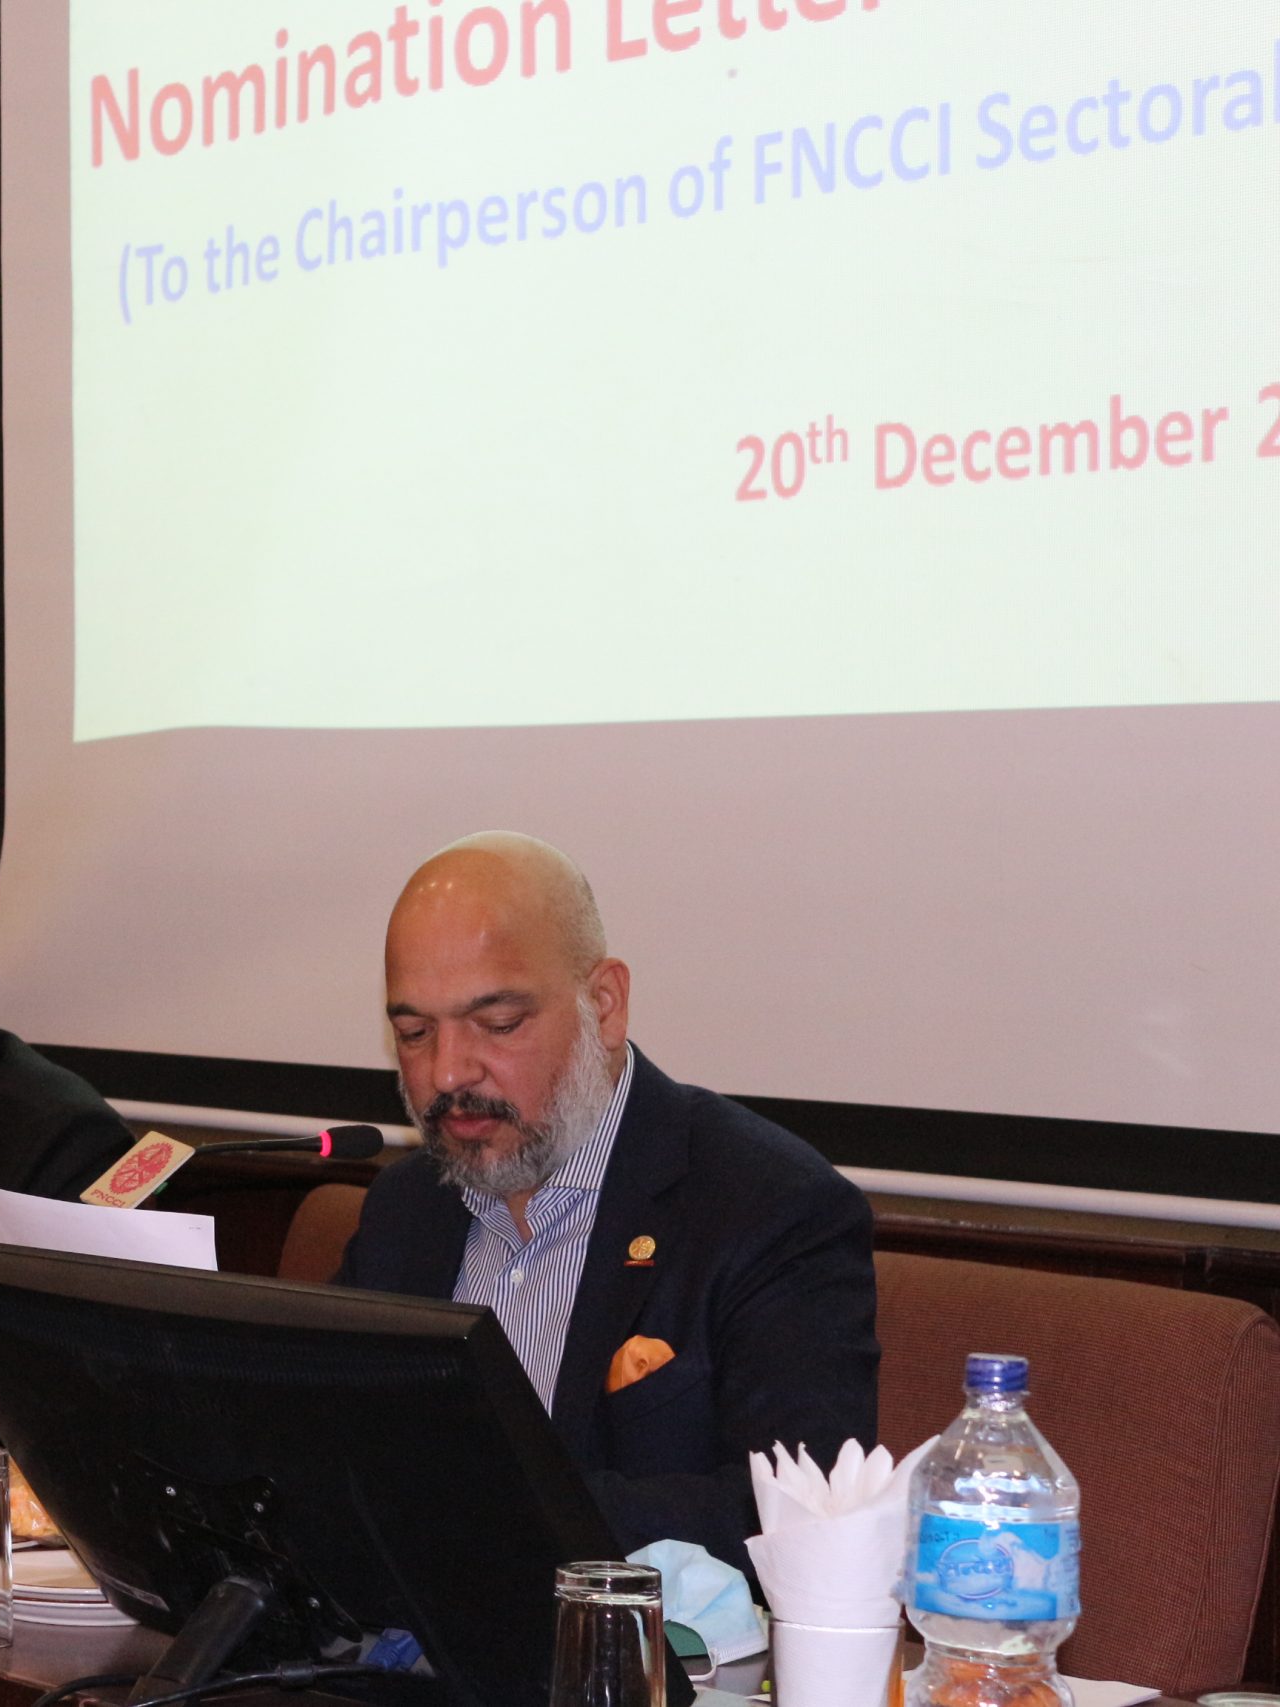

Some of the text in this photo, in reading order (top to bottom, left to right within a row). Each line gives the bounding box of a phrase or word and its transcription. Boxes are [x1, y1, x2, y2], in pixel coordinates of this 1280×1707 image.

[92, 0, 572, 168] Nomination
[118, 38, 1280, 325] (To the Chairperson of FNCCI Sectoral
[735, 414, 849, 502] 20th
[874, 394, 1229, 490] December
[90, 1188, 127, 1208] FNCCI
